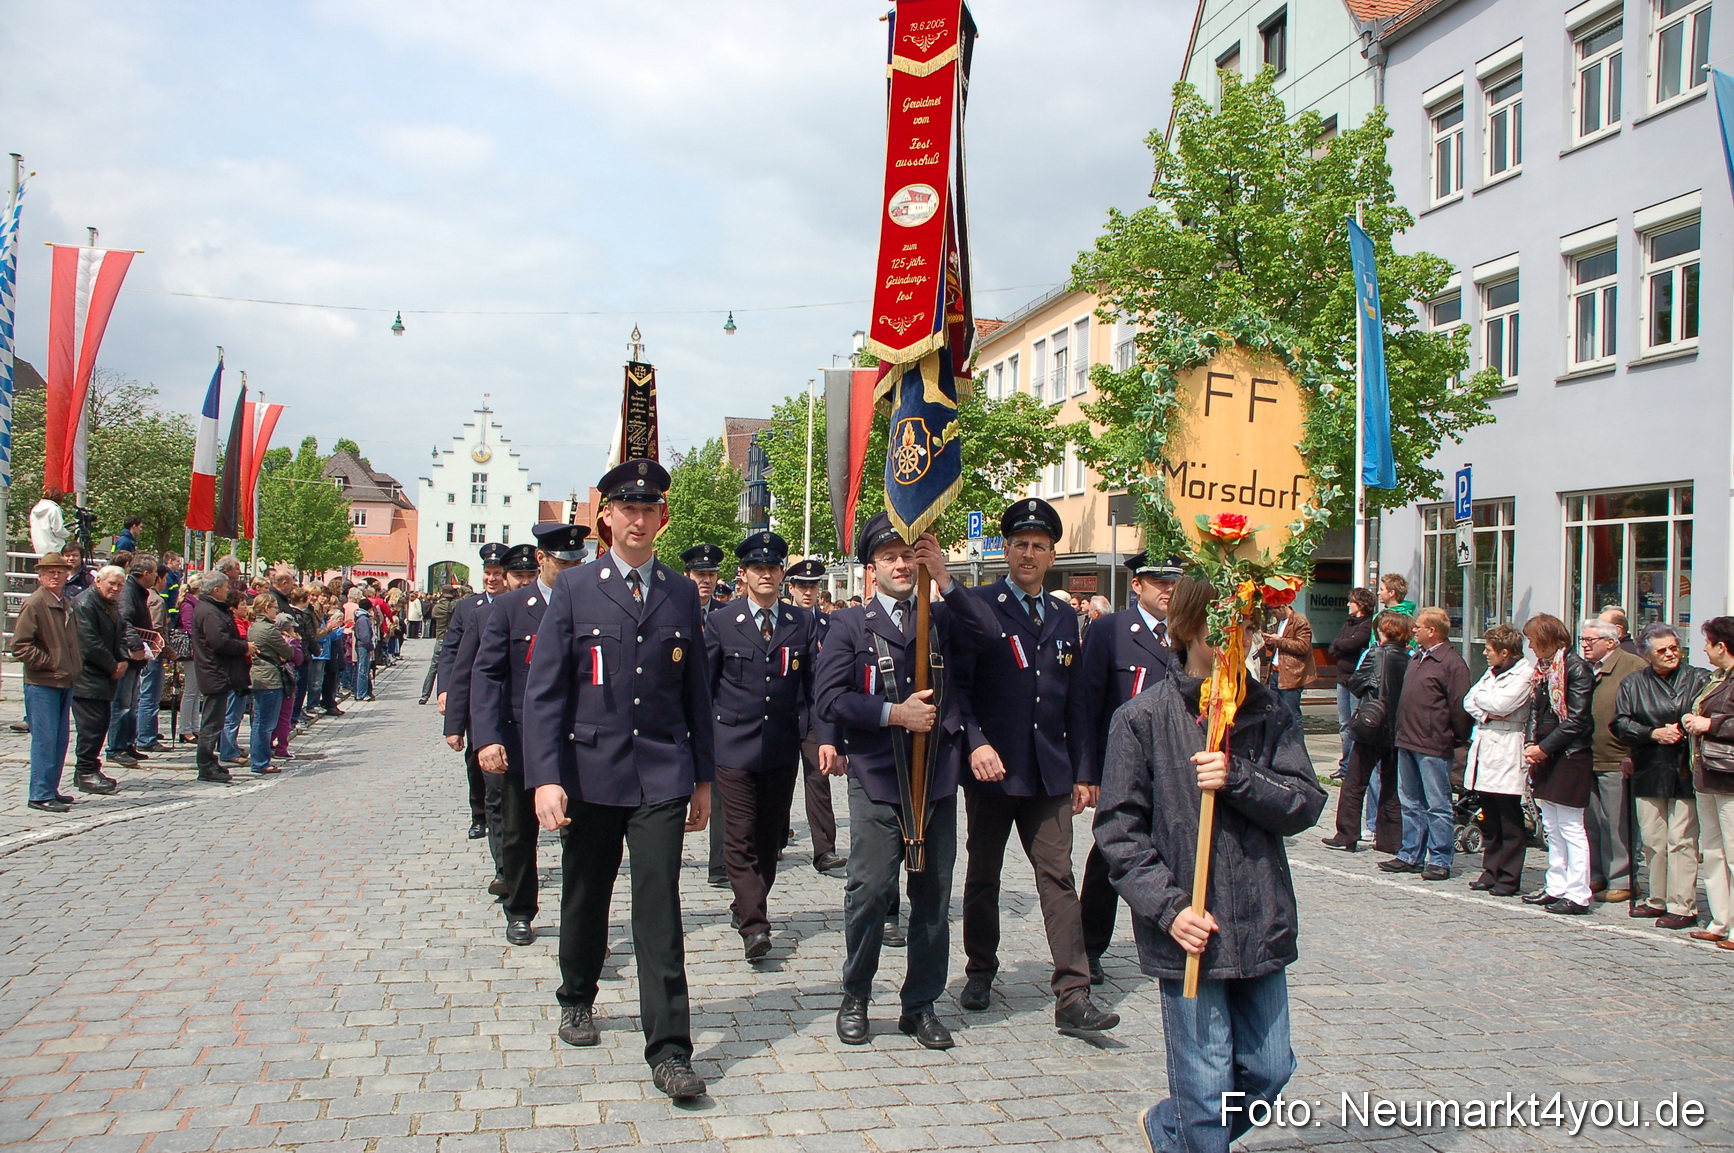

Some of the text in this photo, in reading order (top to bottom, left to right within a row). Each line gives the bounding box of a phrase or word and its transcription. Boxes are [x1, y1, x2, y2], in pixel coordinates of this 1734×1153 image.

[909, 18, 946, 32] 19.6.2005
[902, 96, 942, 113] Gewidmet
[912, 116, 930, 125] vom
[895, 152, 940, 168] ausschuß
[902, 243, 917, 251] zum
[896, 290, 914, 304] fest
[1162, 459, 1310, 511] Mörsdorf
[1458, 475, 1468, 514] P
[971, 515, 979, 535] P
[352, 569, 388, 577] Sparkasse
